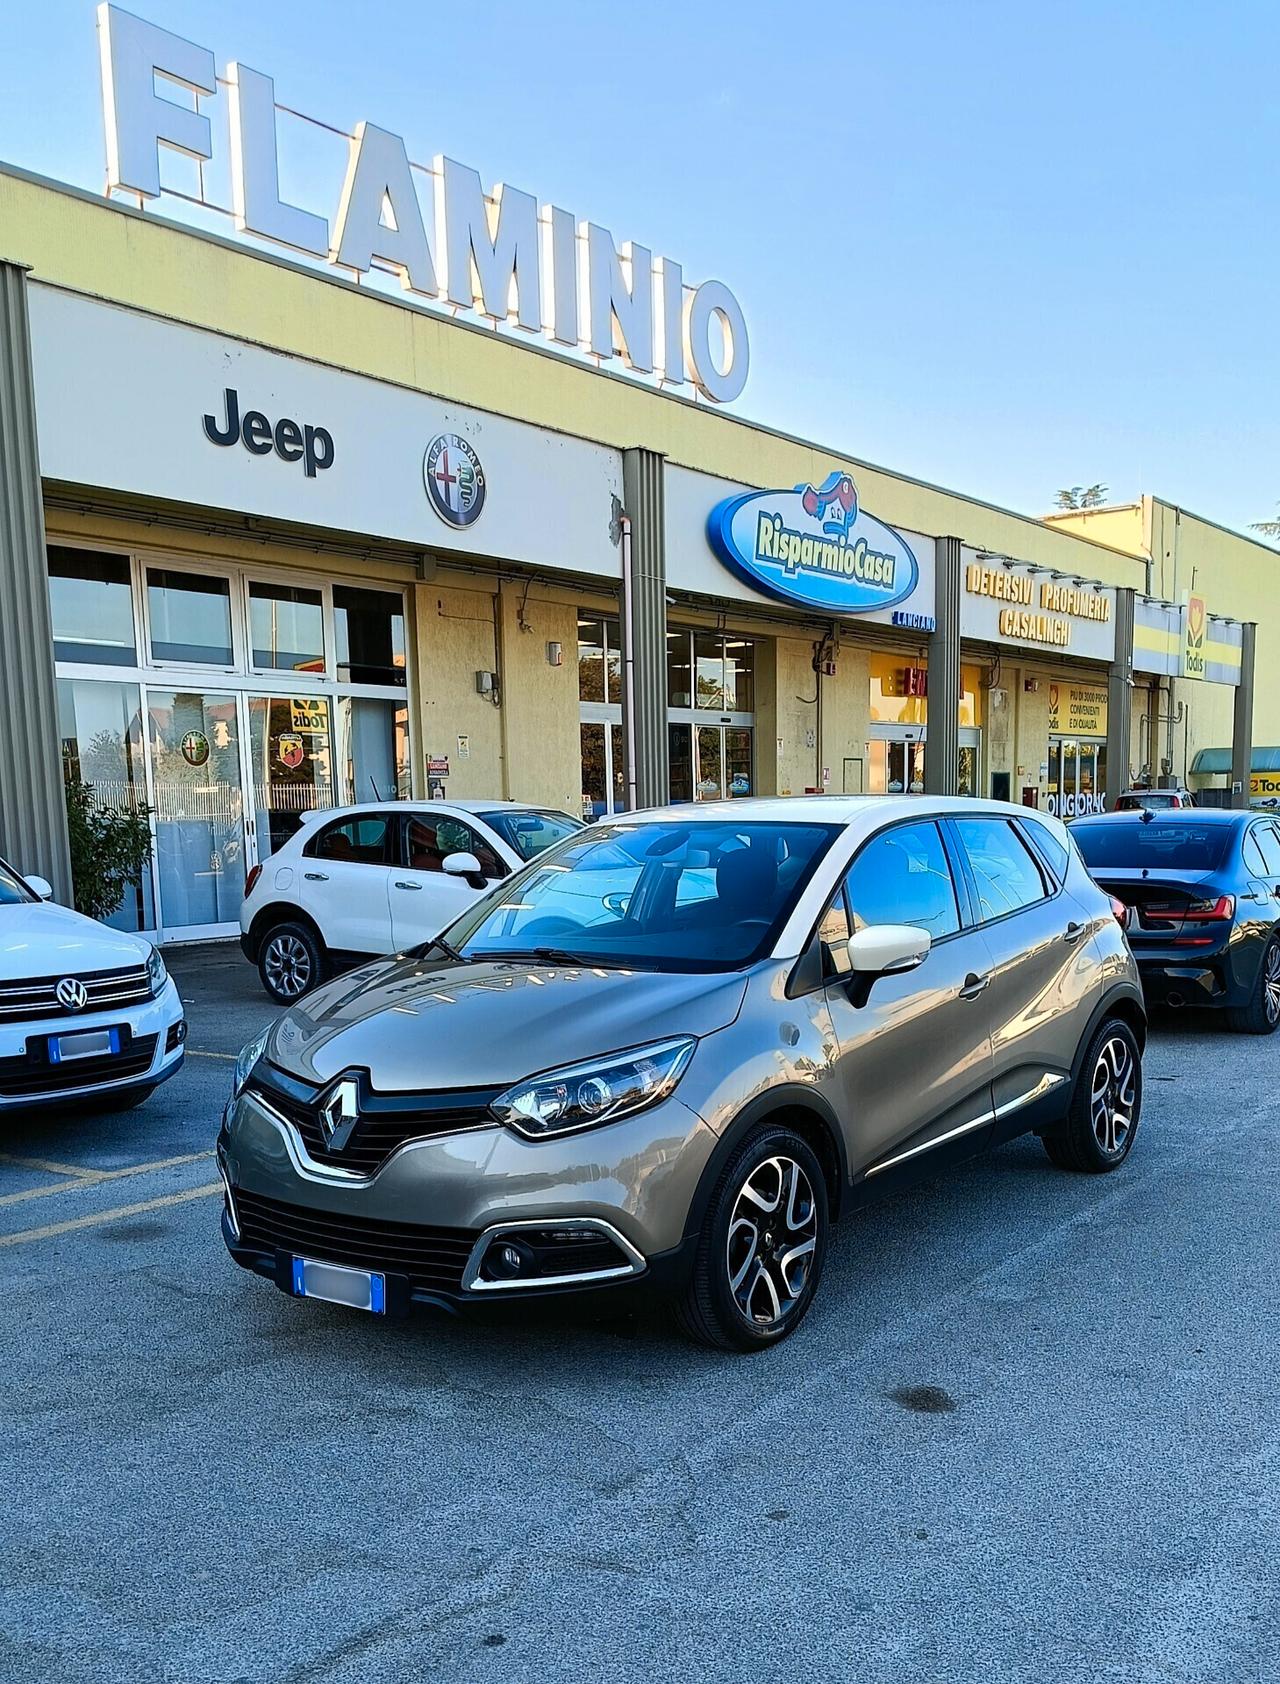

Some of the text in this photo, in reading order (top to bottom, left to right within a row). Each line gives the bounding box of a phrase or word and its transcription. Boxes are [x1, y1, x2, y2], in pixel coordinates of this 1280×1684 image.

[98, 4, 750, 403] FLAMINIO
[202, 387, 335, 478] Jeep
[428, 436, 484, 487] ALFA ROMEO
[757, 513, 896, 586] RisparmioCasa
[967, 565, 1111, 621] DETERSIVI PROFUMERIA
[894, 611, 936, 631] LANCIANO
[1000, 608, 1071, 646] CASALINGHI
[1186, 650, 1203, 672] Todis
